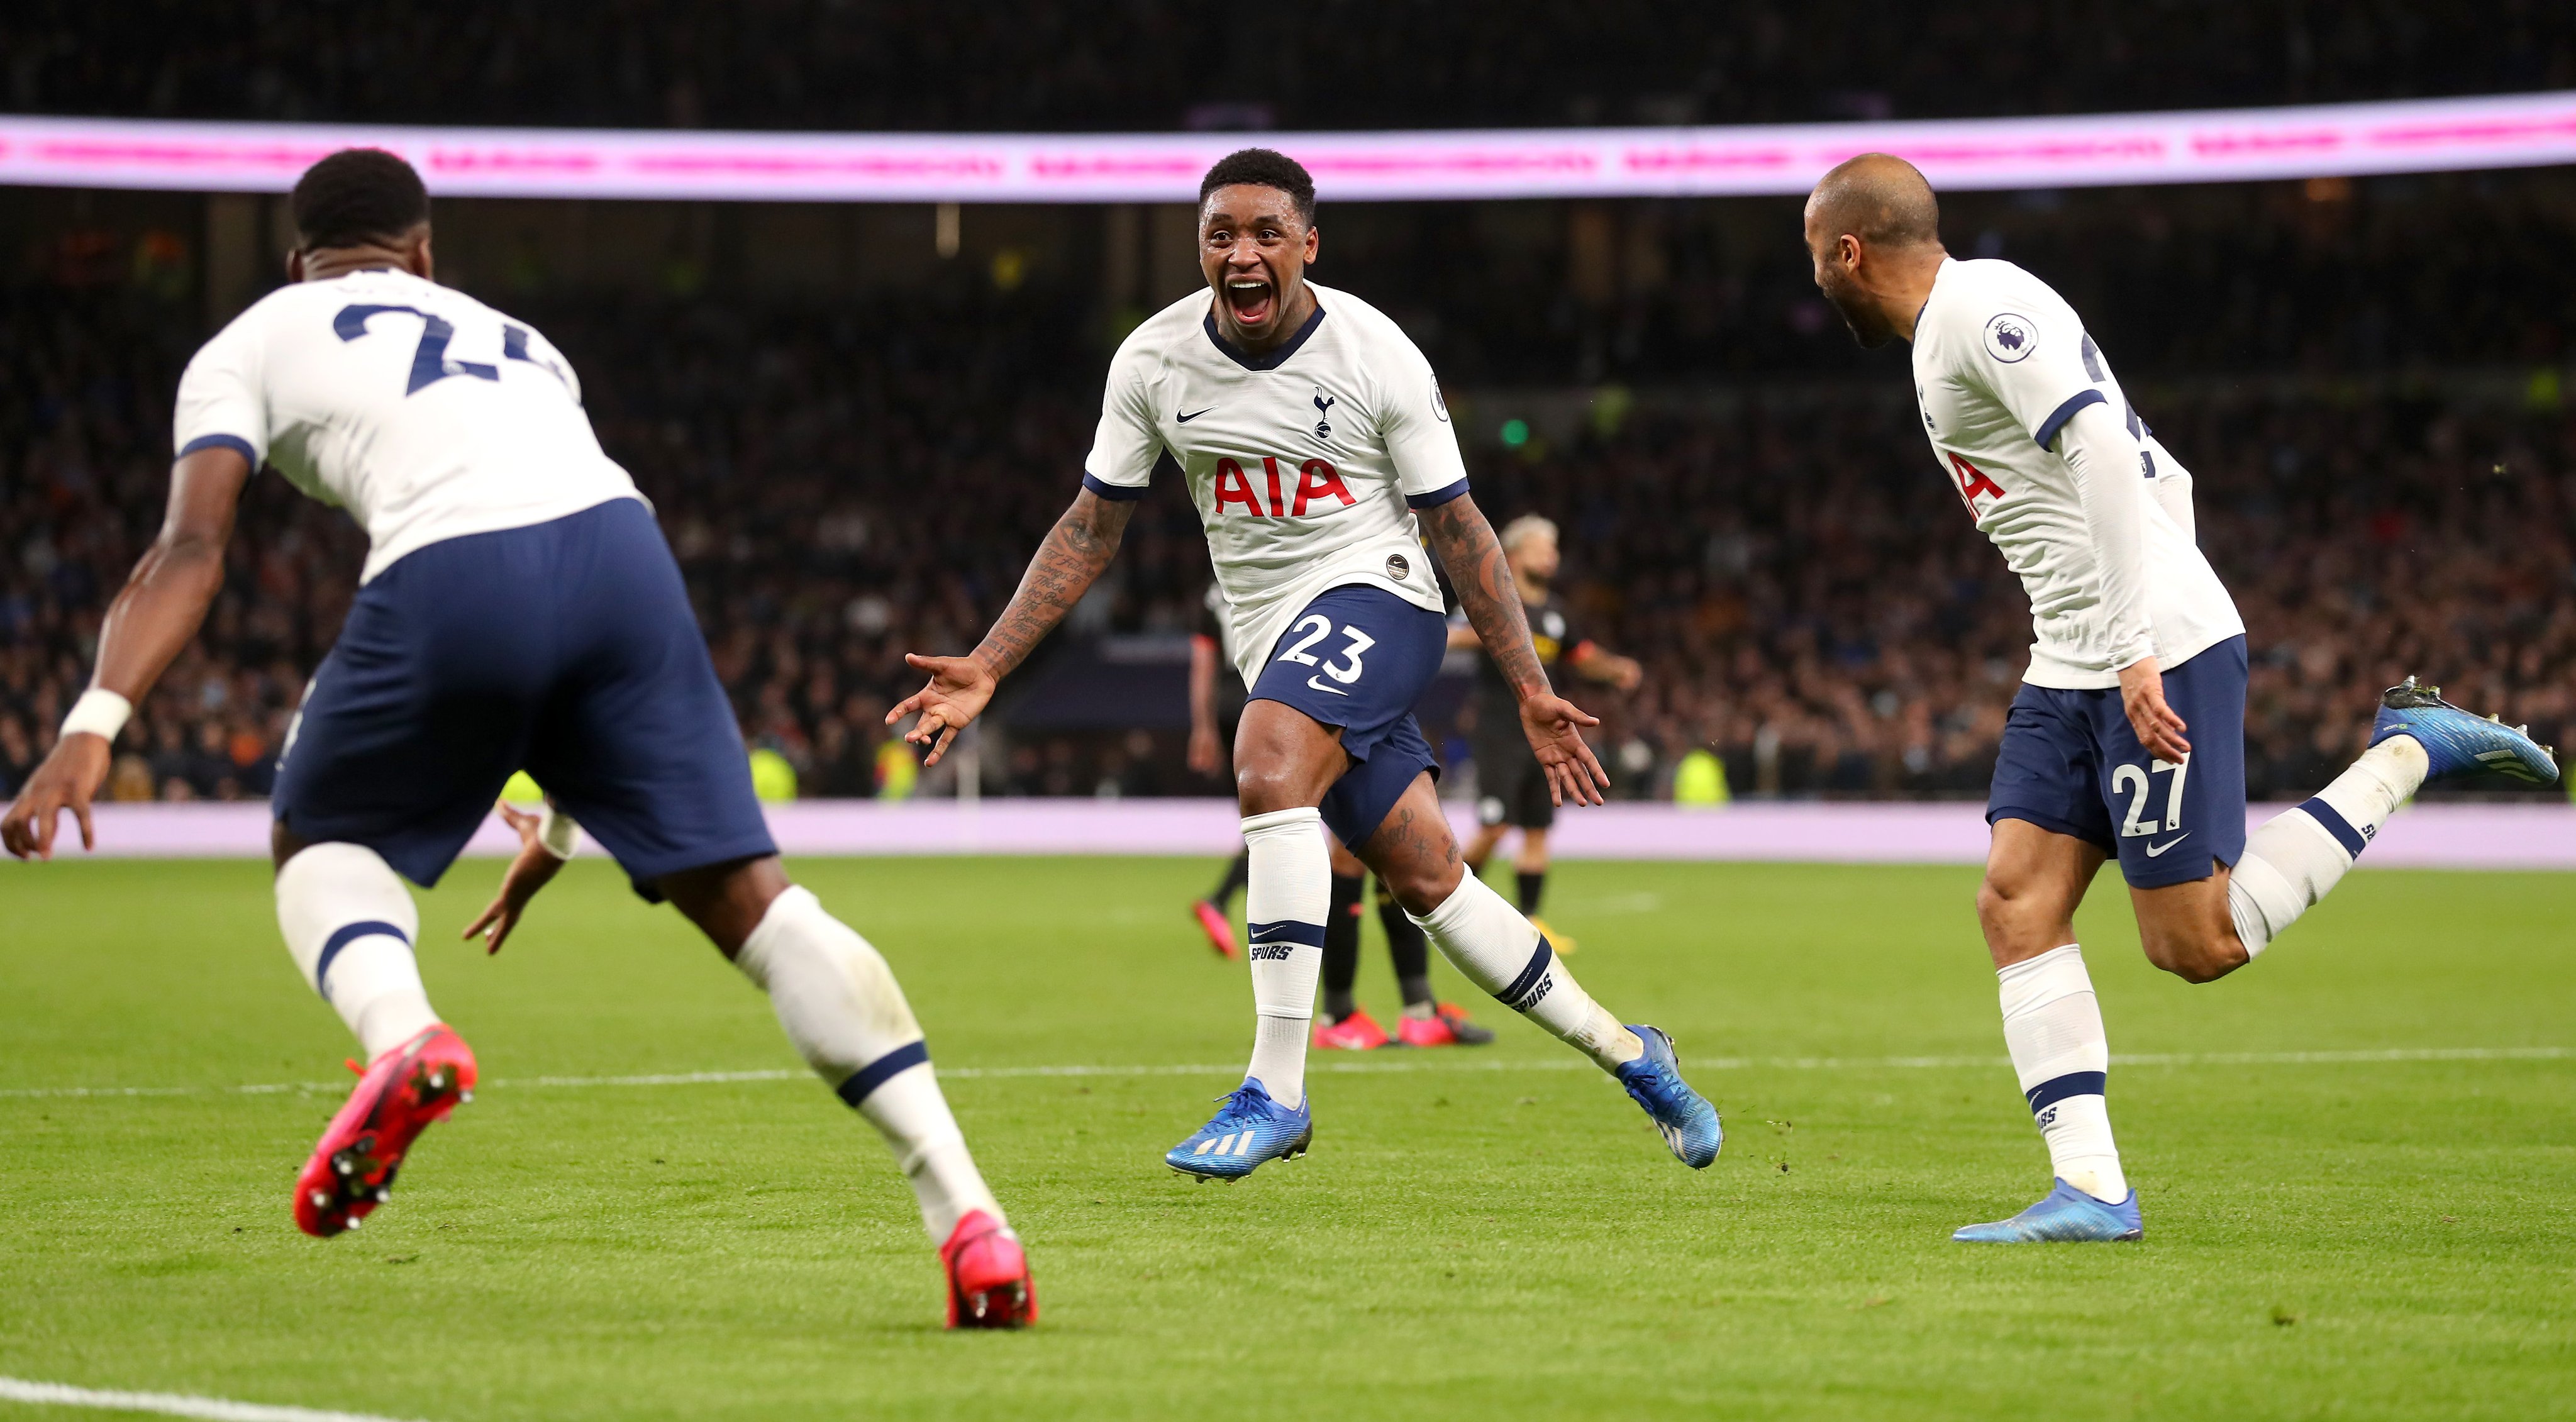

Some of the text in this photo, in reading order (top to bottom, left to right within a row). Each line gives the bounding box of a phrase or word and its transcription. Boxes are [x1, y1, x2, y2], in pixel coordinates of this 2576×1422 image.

[1215, 457, 1357, 517] AIA
[1943, 452, 2006, 523] A
[1031, 575, 1066, 593] Those
[1277, 614, 1375, 684] 23
[2112, 751, 2190, 837] 27
[1252, 945, 1294, 961] SPURS
